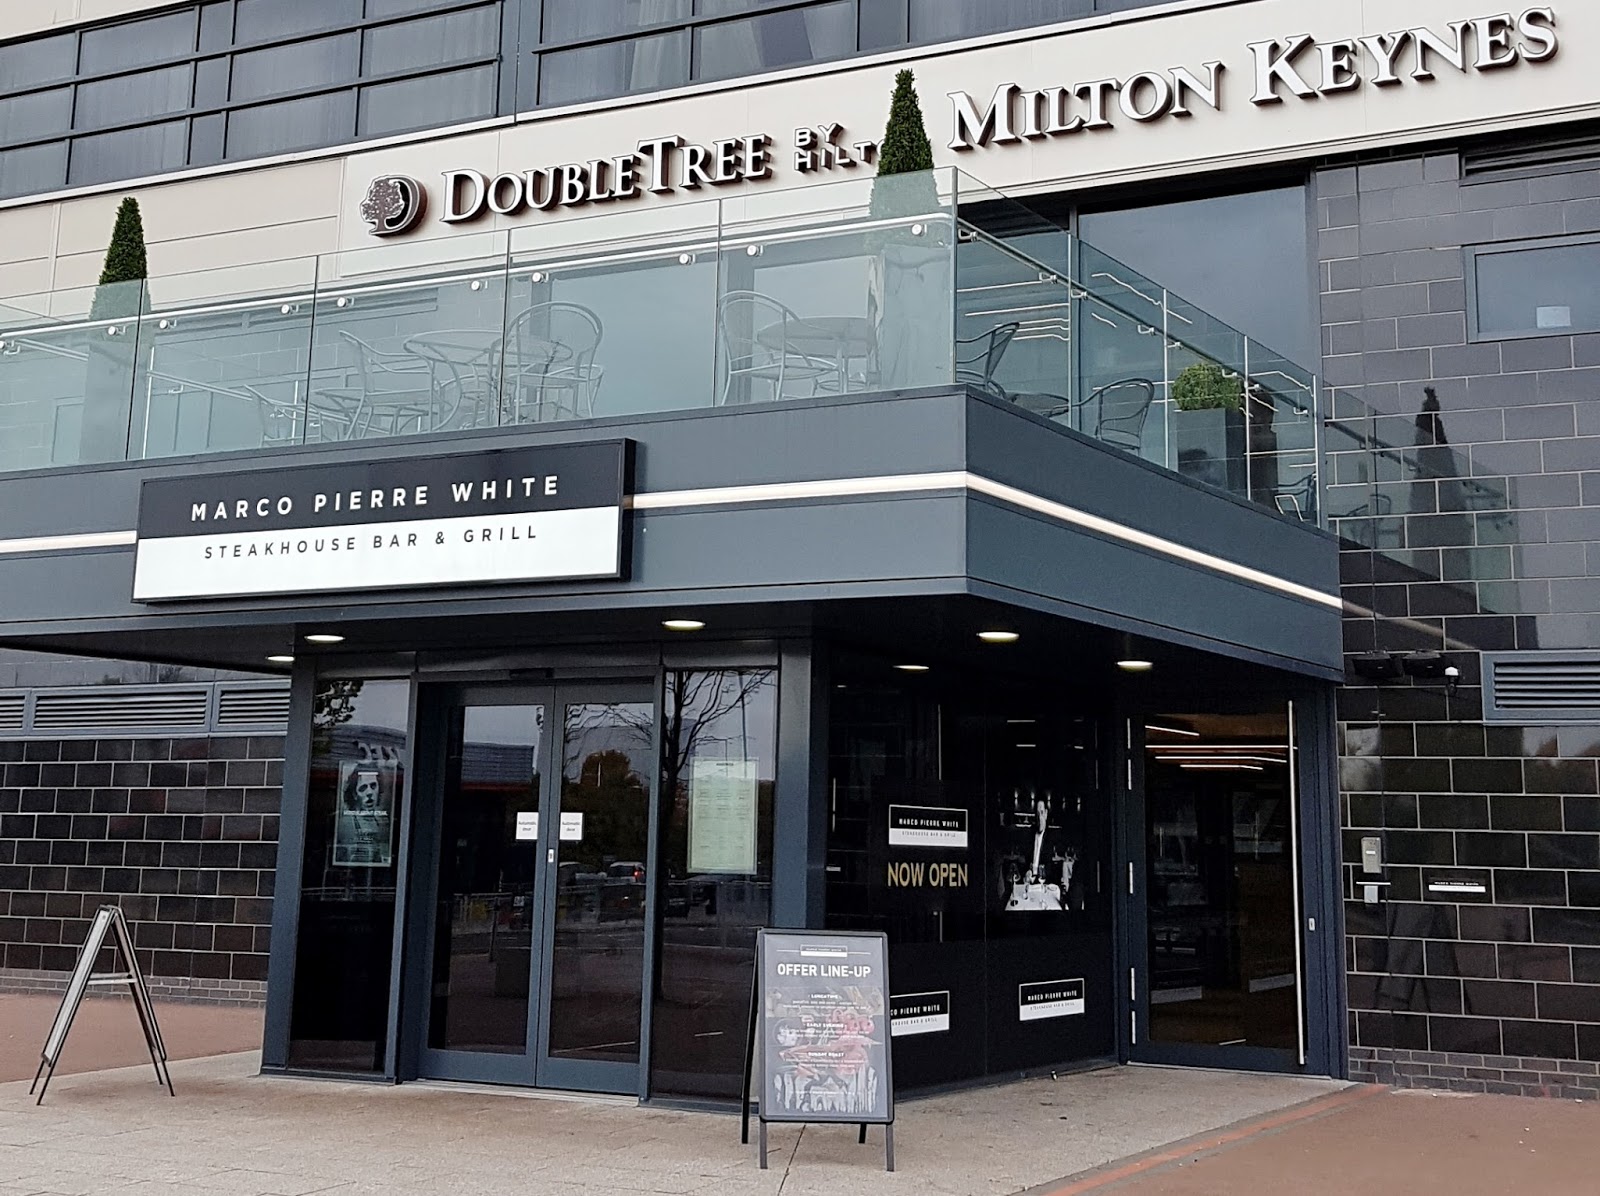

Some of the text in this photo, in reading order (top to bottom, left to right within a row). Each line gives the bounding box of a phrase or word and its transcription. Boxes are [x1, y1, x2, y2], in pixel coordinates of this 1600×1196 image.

[947, 6, 1558, 150] MILTON KEYNES
[795, 123, 841, 149] BY
[795, 139, 884, 173] HILT
[191, 475, 558, 521] MARCO PIERRE WHITE
[204, 525, 536, 559] STEAKHOUSE BAR & GRILL
[888, 862, 968, 887] NOW OPEN
[777, 963, 871, 978] OFFER LINE-UP
